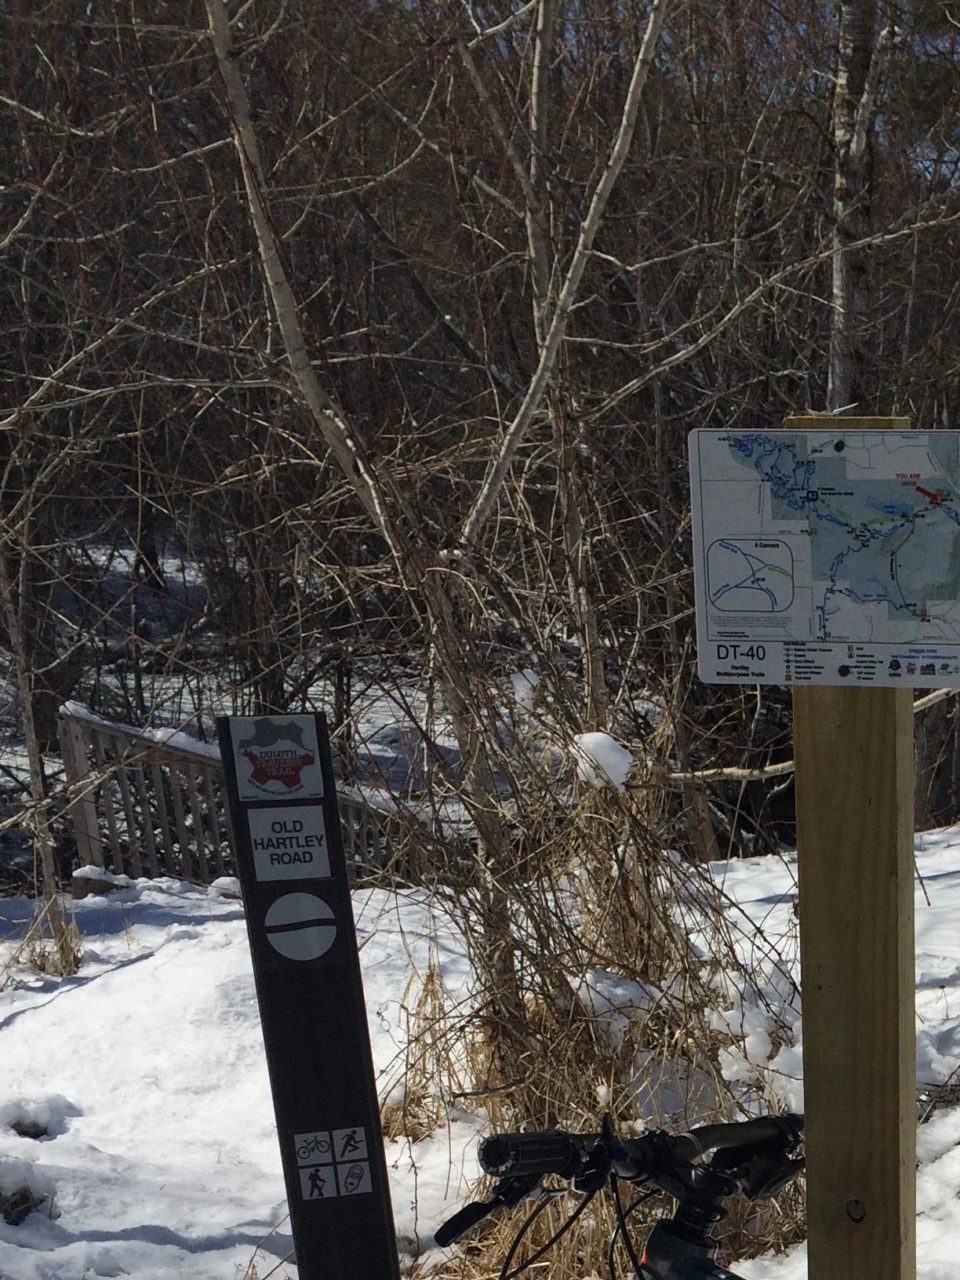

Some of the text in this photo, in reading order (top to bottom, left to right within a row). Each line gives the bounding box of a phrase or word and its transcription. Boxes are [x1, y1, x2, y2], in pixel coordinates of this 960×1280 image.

[717, 645, 766, 660] DT-40
[266, 768, 295, 776] TRAIL
[271, 820, 304, 834] OLD
[253, 834, 325, 851] HARTLEY
[269, 851, 313, 866] ROAD
